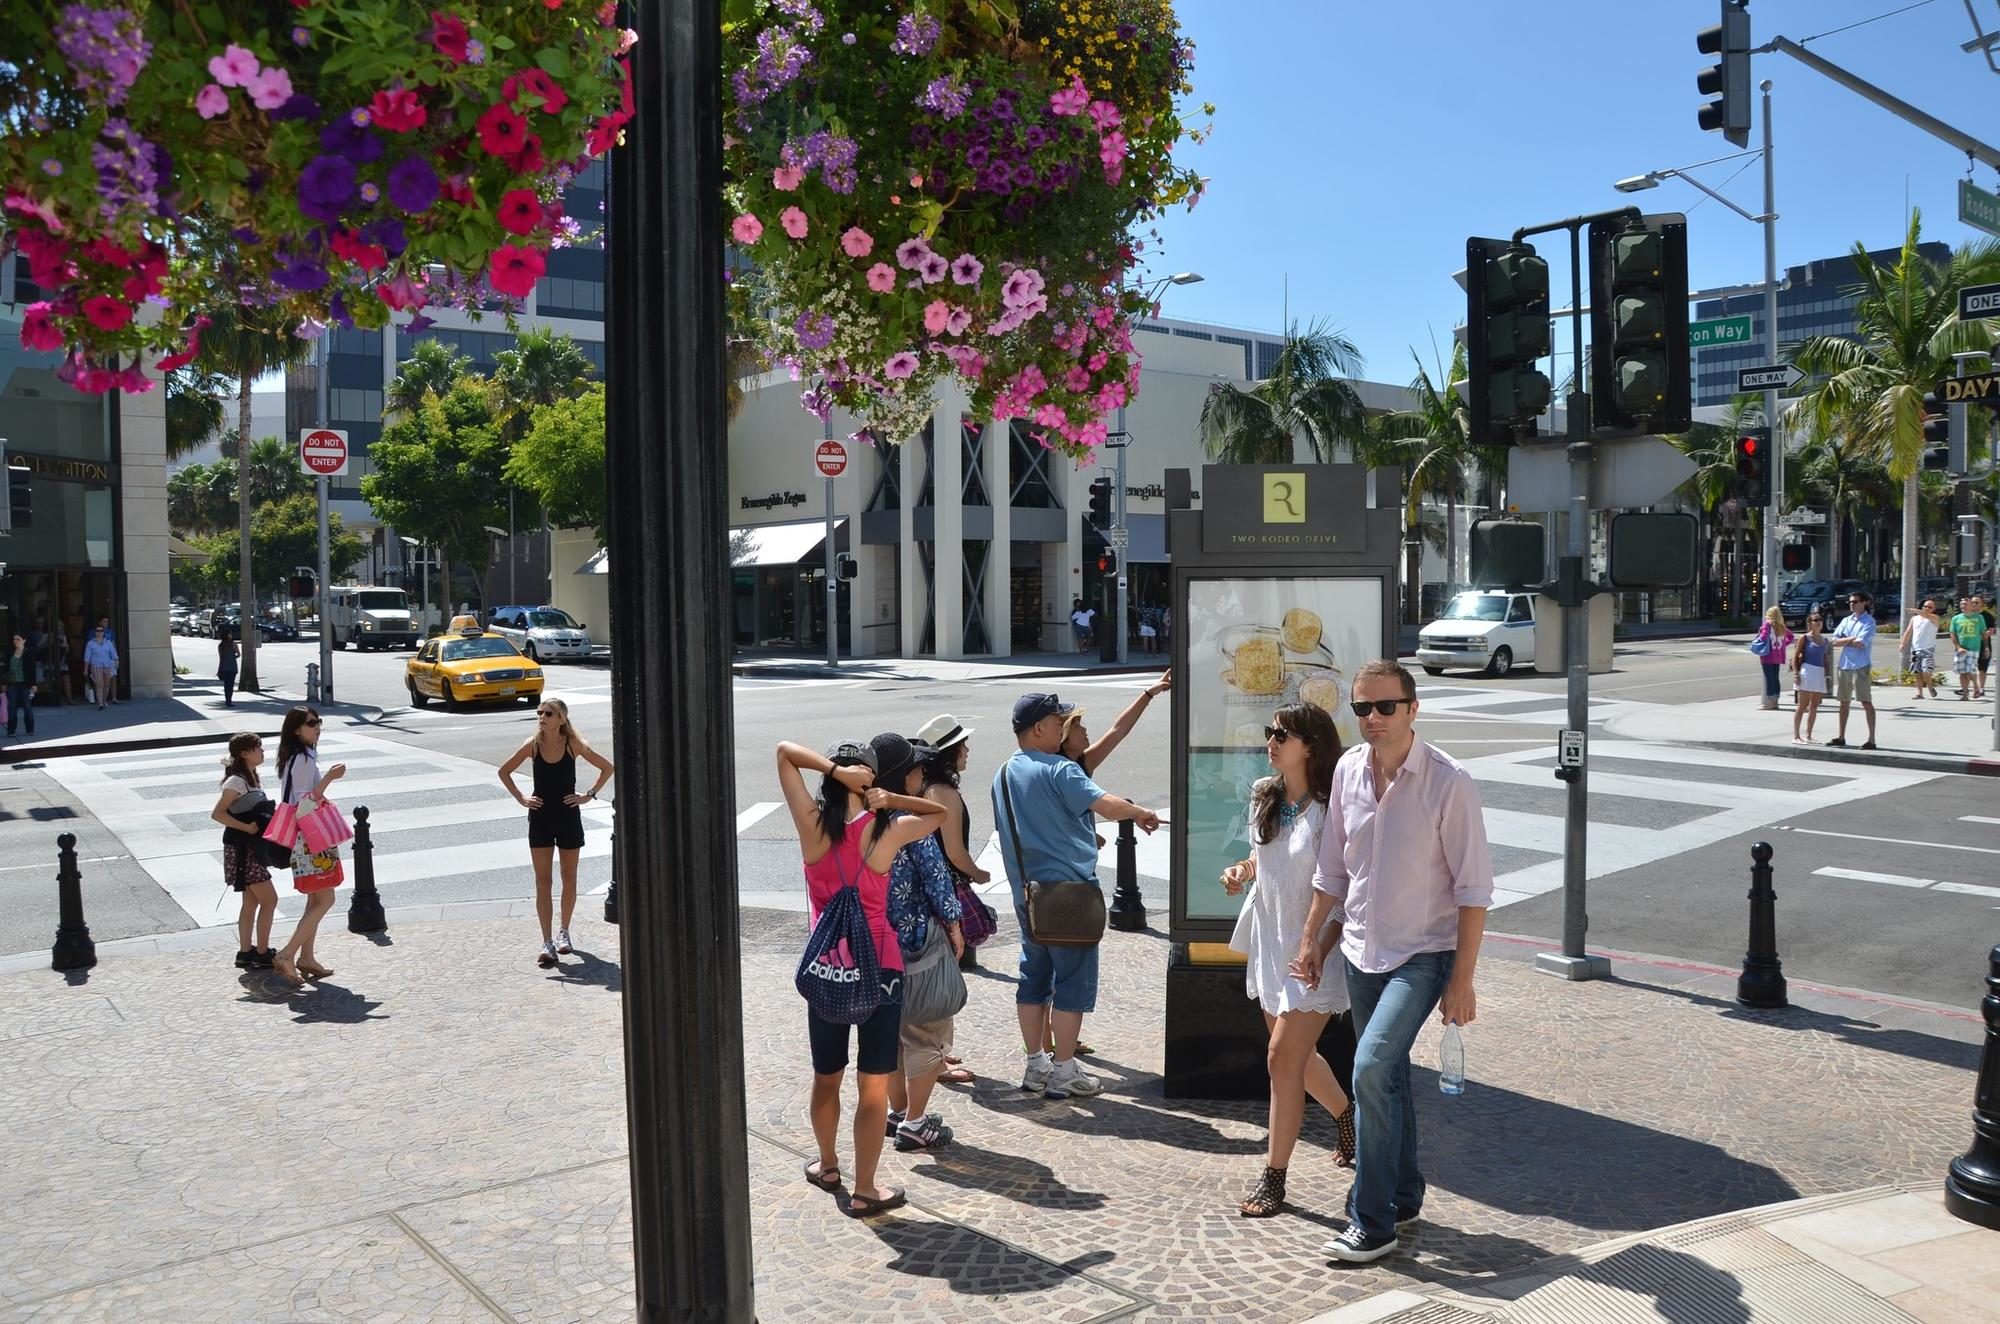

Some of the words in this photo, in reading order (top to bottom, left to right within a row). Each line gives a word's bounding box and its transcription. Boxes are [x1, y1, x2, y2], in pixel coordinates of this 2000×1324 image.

[1966, 193, 1994, 222] Rodeo
[1971, 294, 2000, 309] ONE
[1715, 325, 1743, 339] Way
[1745, 375, 1764, 384] ONE
[1766, 372, 1786, 382] WAY
[309, 438, 320, 446] DO
[324, 439, 340, 447] NOT
[312, 458, 337, 466] ENTER
[1232, 535, 1256, 543] TWO
[1262, 535, 1300, 543] RODEO
[1305, 535, 1337, 543] DRIVE
[808, 961, 860, 982] adidas
